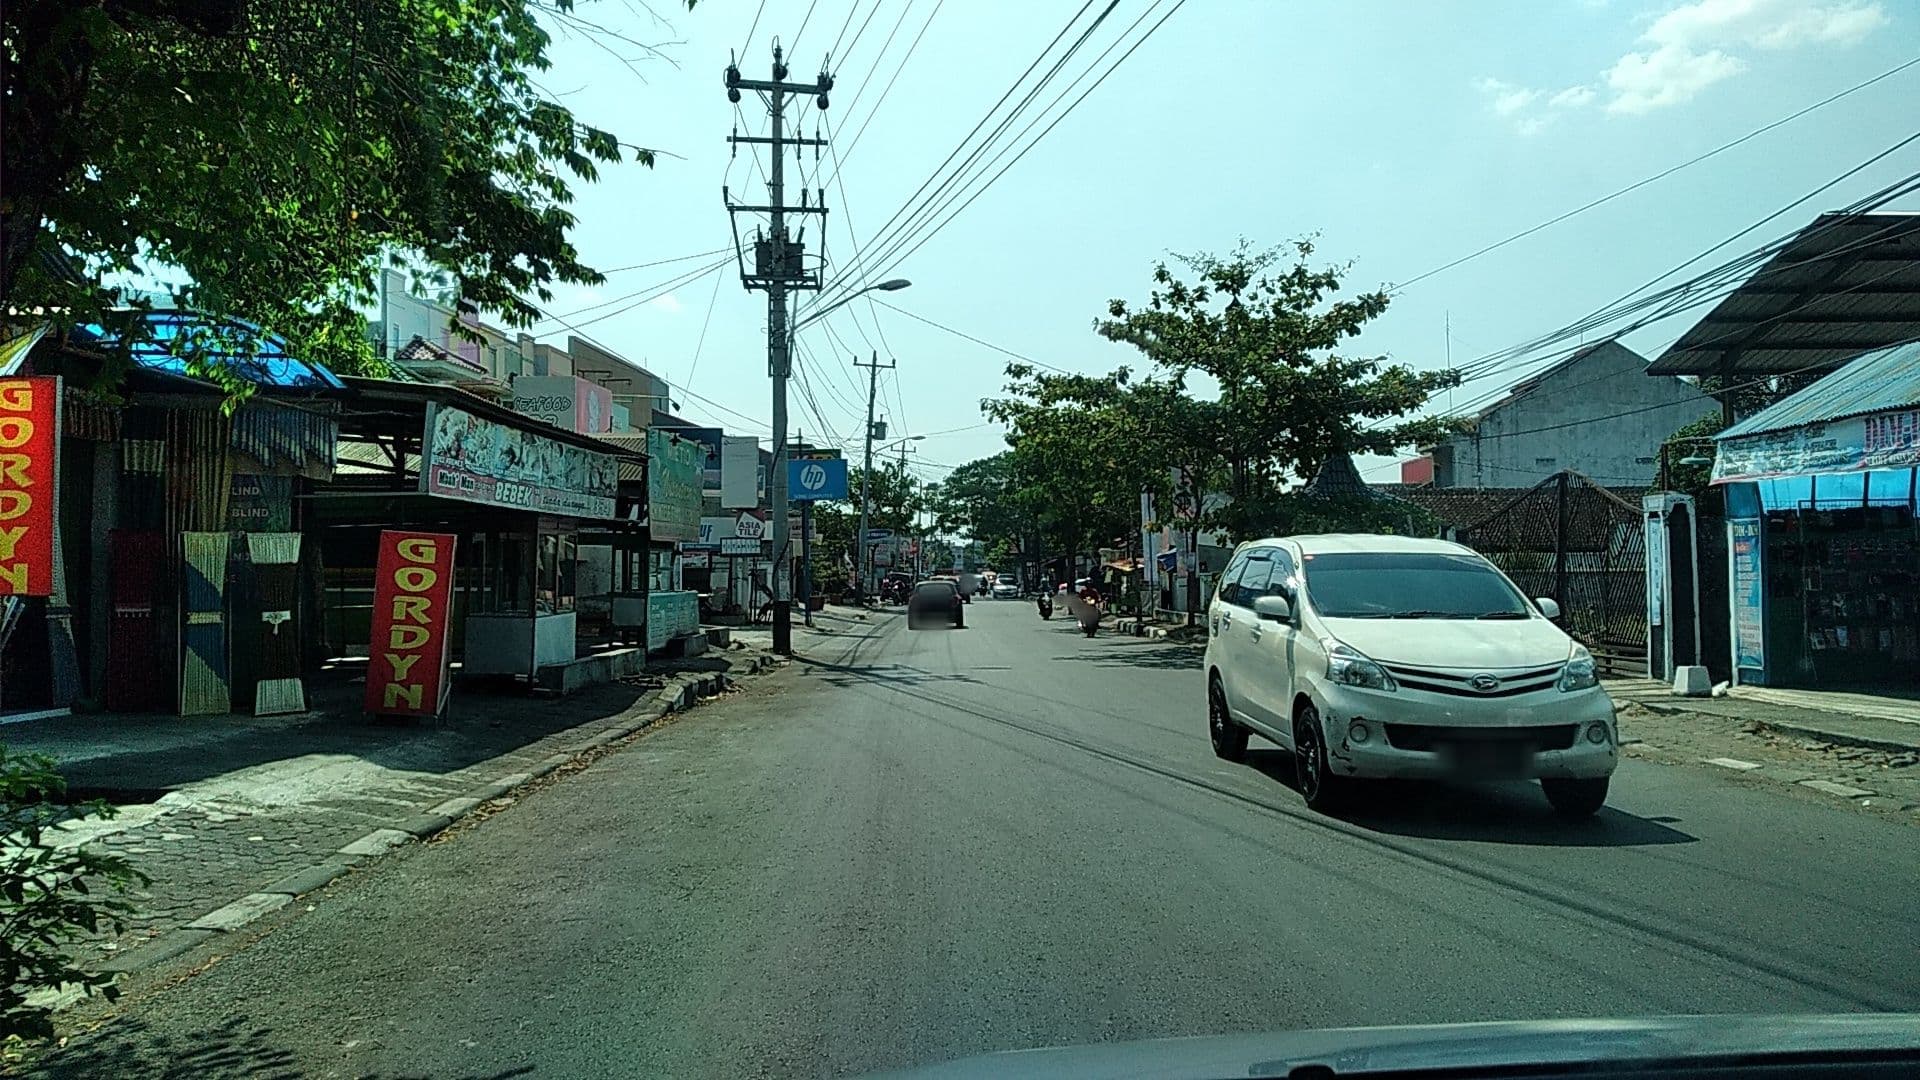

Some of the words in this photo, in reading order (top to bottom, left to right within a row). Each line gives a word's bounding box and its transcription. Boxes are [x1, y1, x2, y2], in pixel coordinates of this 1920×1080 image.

[514, 396, 572, 412] SEAFOOD
[0, 380, 35, 594] GORDYN
[804, 465, 823, 490] hp
[495, 482, 532, 507] BEBEK
[738, 521, 761, 529] ASIA
[383, 537, 438, 710] GORDYN
